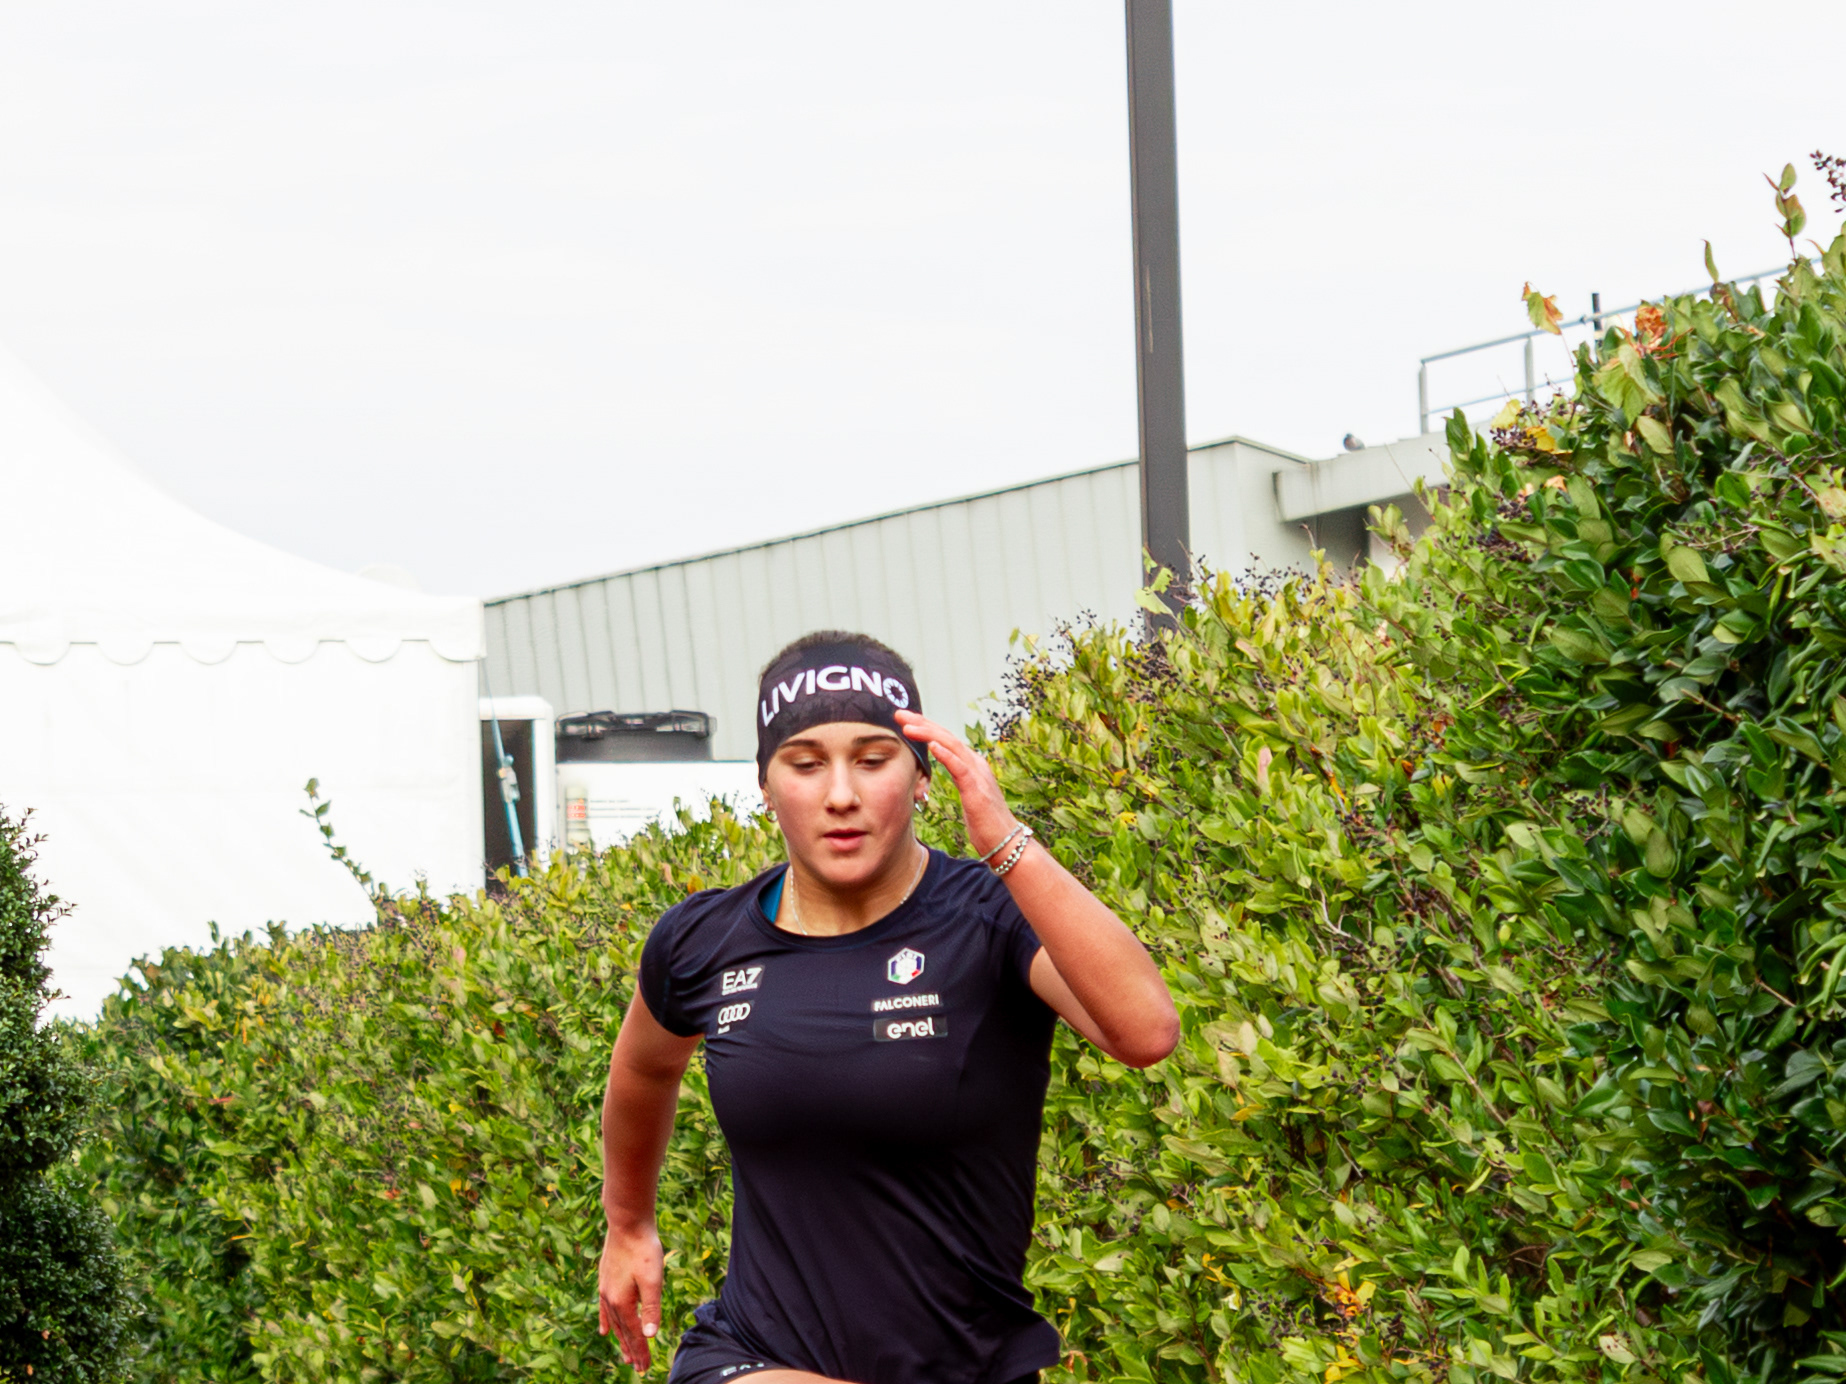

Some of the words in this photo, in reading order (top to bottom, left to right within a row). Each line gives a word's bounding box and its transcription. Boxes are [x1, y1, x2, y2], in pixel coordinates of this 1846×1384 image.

[761, 665, 909, 727] LIVIGNO
[722, 967, 762, 990] EA7
[873, 993, 939, 1012] FALCONERI
[887, 1017, 935, 1039] enel
